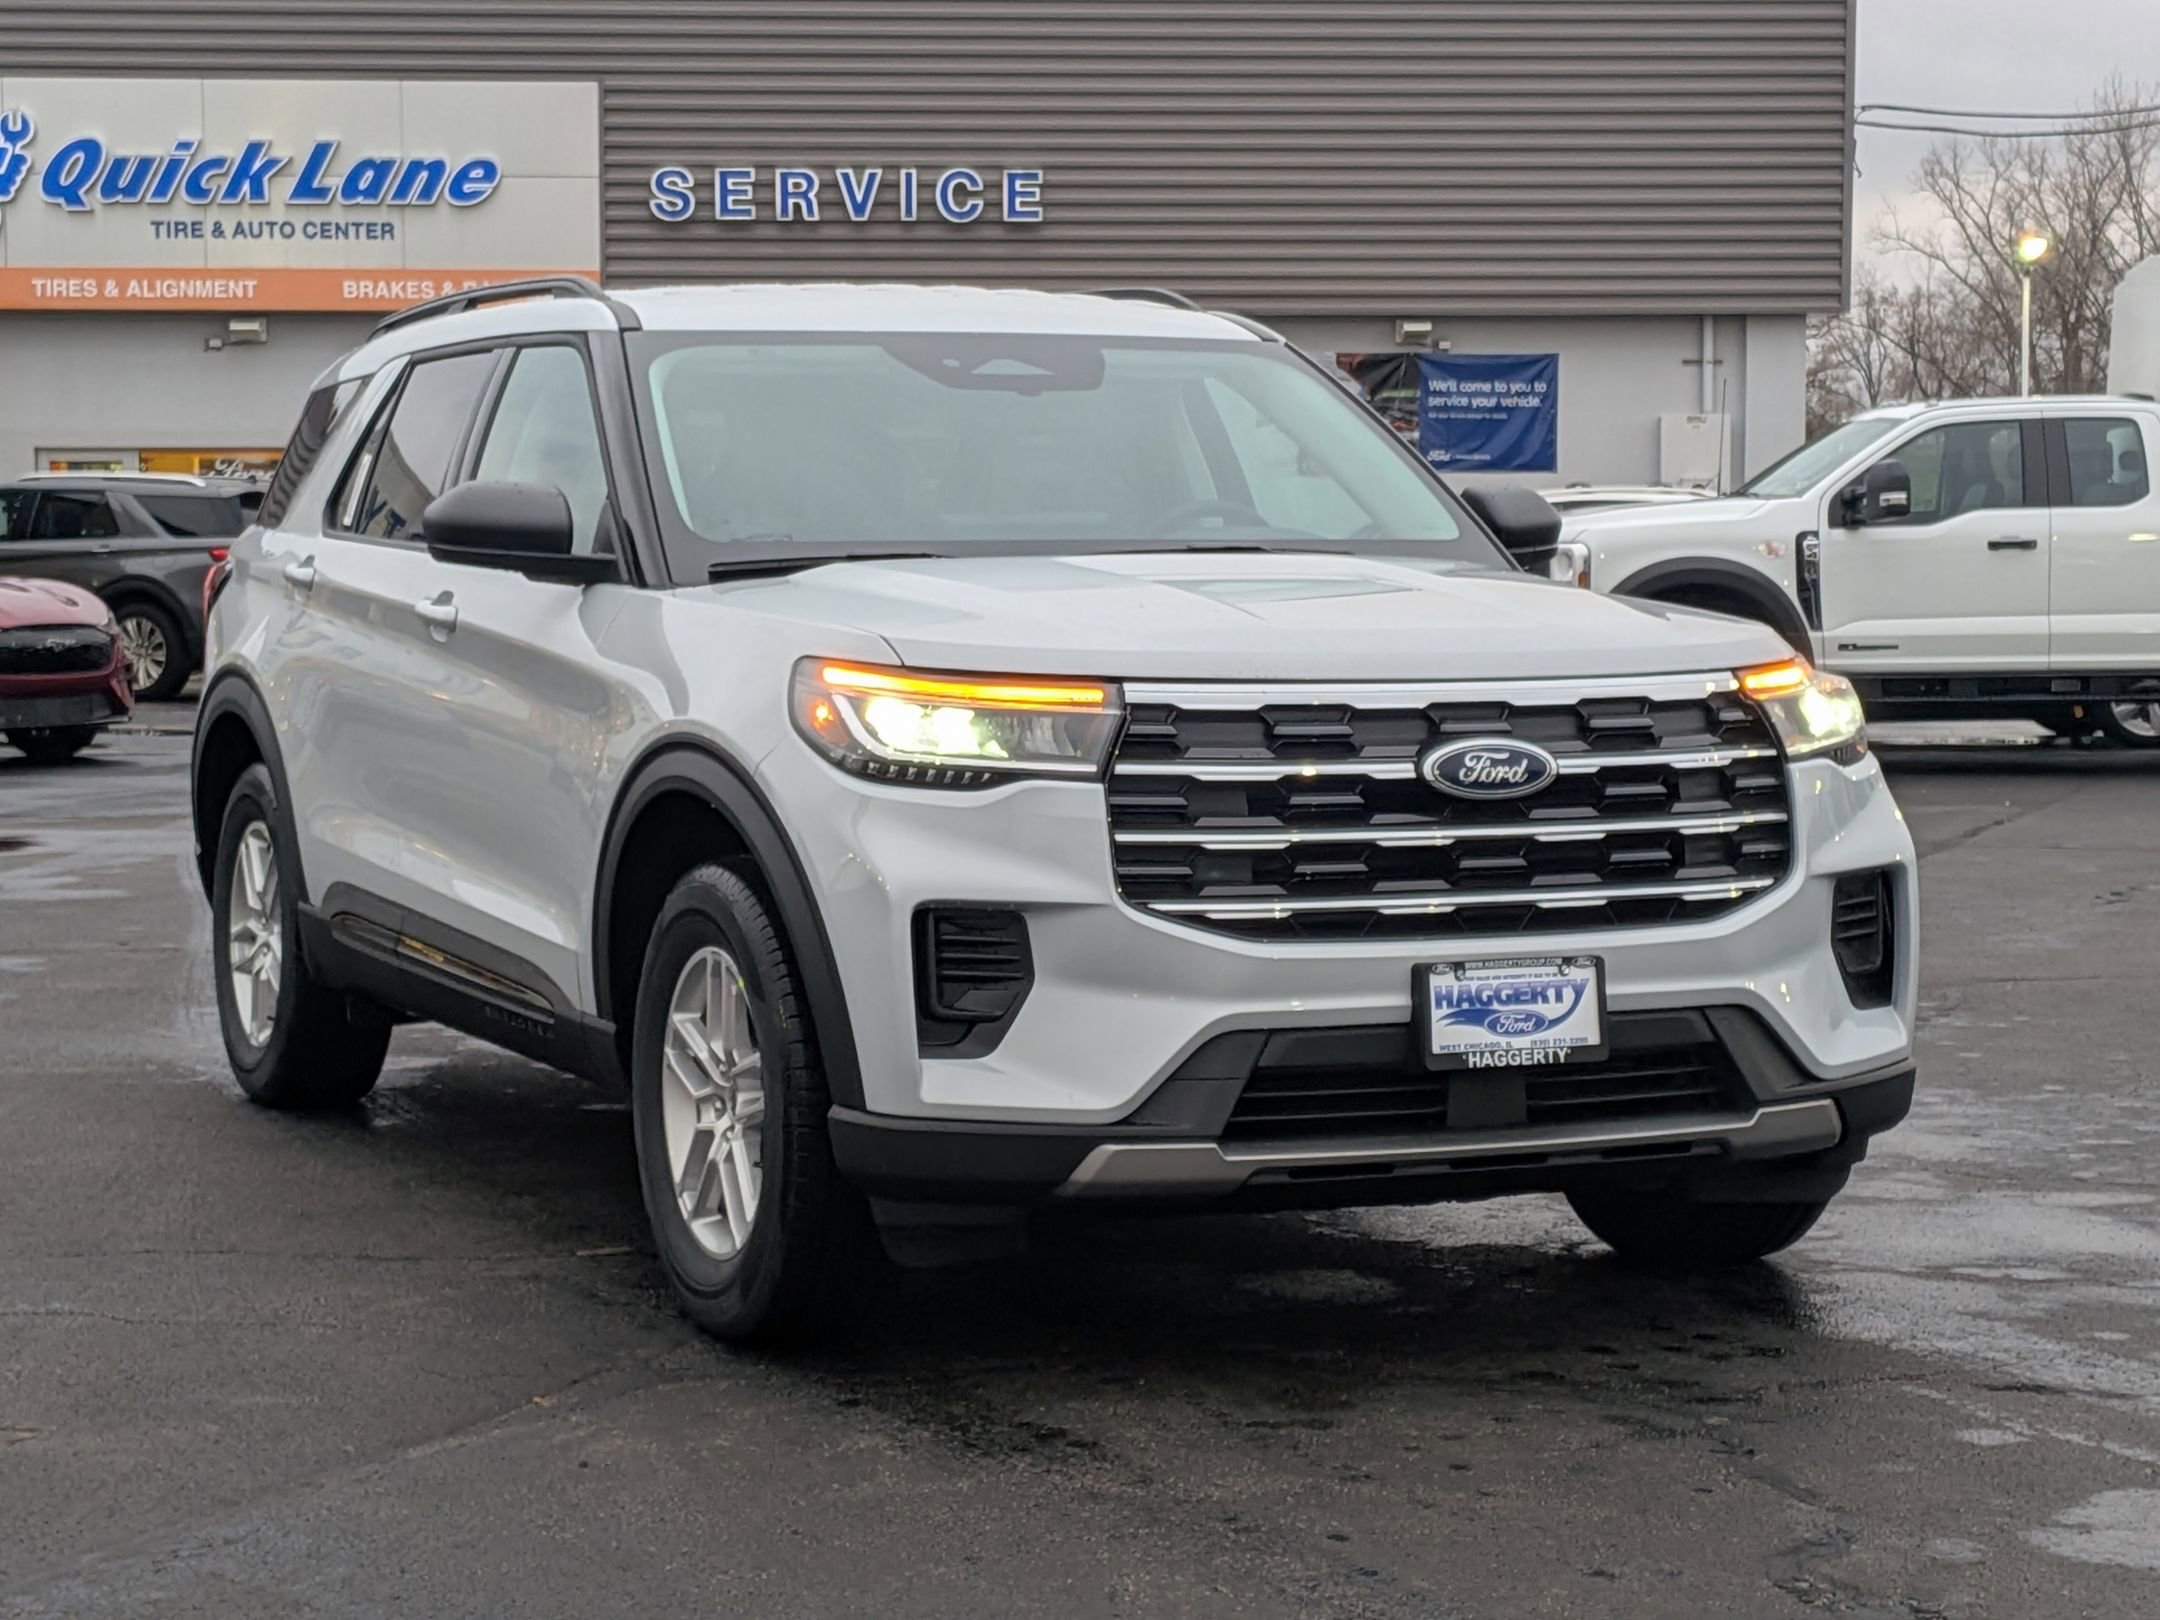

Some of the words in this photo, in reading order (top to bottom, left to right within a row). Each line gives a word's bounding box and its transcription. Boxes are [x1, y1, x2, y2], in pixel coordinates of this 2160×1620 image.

[41, 136, 293, 211] Quick
[284, 139, 502, 206] Lane
[649, 166, 1043, 223] SERVICE
[151, 220, 204, 239] TIRE
[211, 220, 226, 240] &
[232, 220, 296, 239] AUTO
[303, 221, 395, 240] CENTER
[32, 278, 97, 297] TIRES
[104, 279, 119, 298] &
[126, 279, 257, 298] ALIGNMENT
[342, 280, 434, 299] BRAKES
[441, 281, 455, 296] &
[1428, 379, 1457, 392] We'll
[1460, 382, 1491, 392] come
[1494, 380, 1507, 392] to
[1509, 382, 1531, 394] you
[1533, 380, 1547, 392] to
[1428, 395, 1468, 407] service
[1471, 397, 1497, 408] your
[1458, 752, 1528, 785] Ford
[1433, 979, 1589, 1010] HAGGERTY
[1497, 1013, 1537, 1033] Ford
[1468, 1048, 1568, 1069] HAGGERTY
